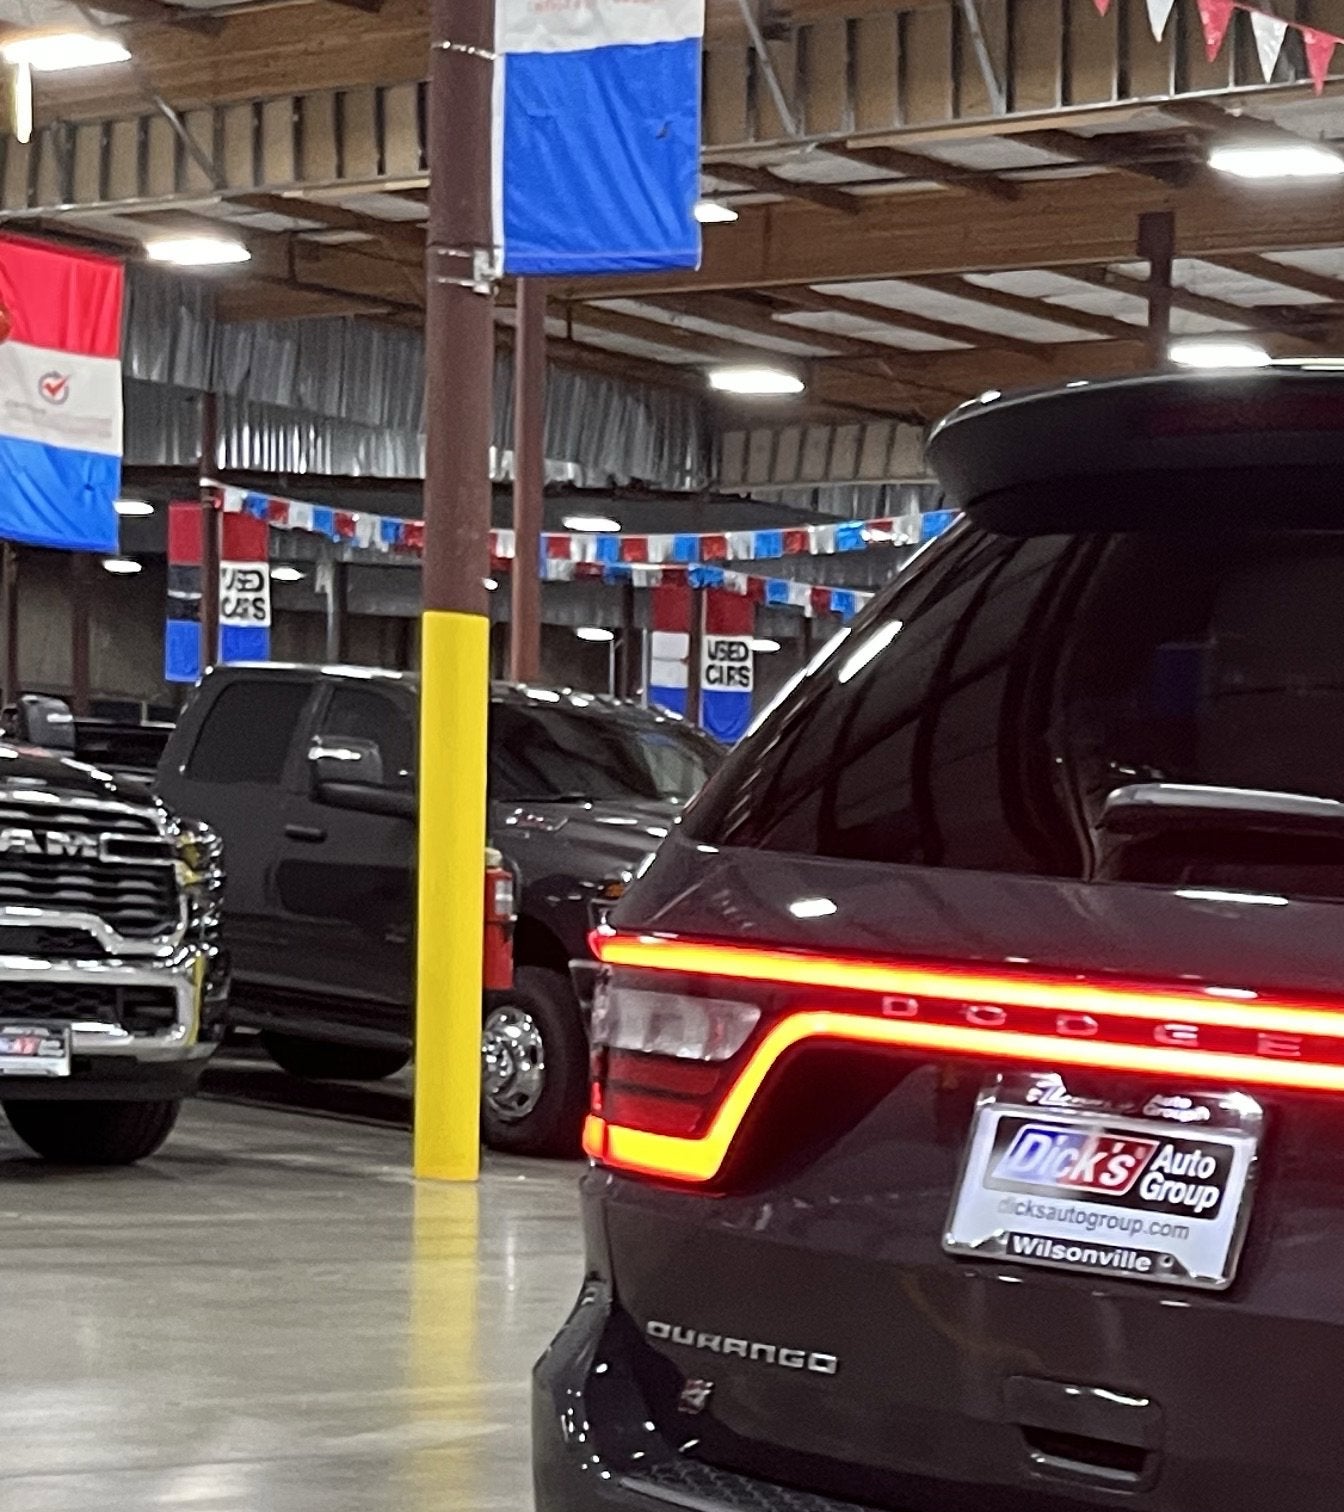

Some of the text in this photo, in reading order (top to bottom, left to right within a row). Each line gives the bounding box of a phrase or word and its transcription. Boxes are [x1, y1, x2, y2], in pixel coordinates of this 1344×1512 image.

[707, 640, 749, 662] USED
[0, 828, 98, 857] AM
[882, 995, 1301, 1057] DODGE
[1150, 1144, 1217, 1179] Auto
[1139, 1170, 1221, 1214] Group
[1011, 1234, 1153, 1273] Wilsonville
[646, 1320, 838, 1375] DURANGO
